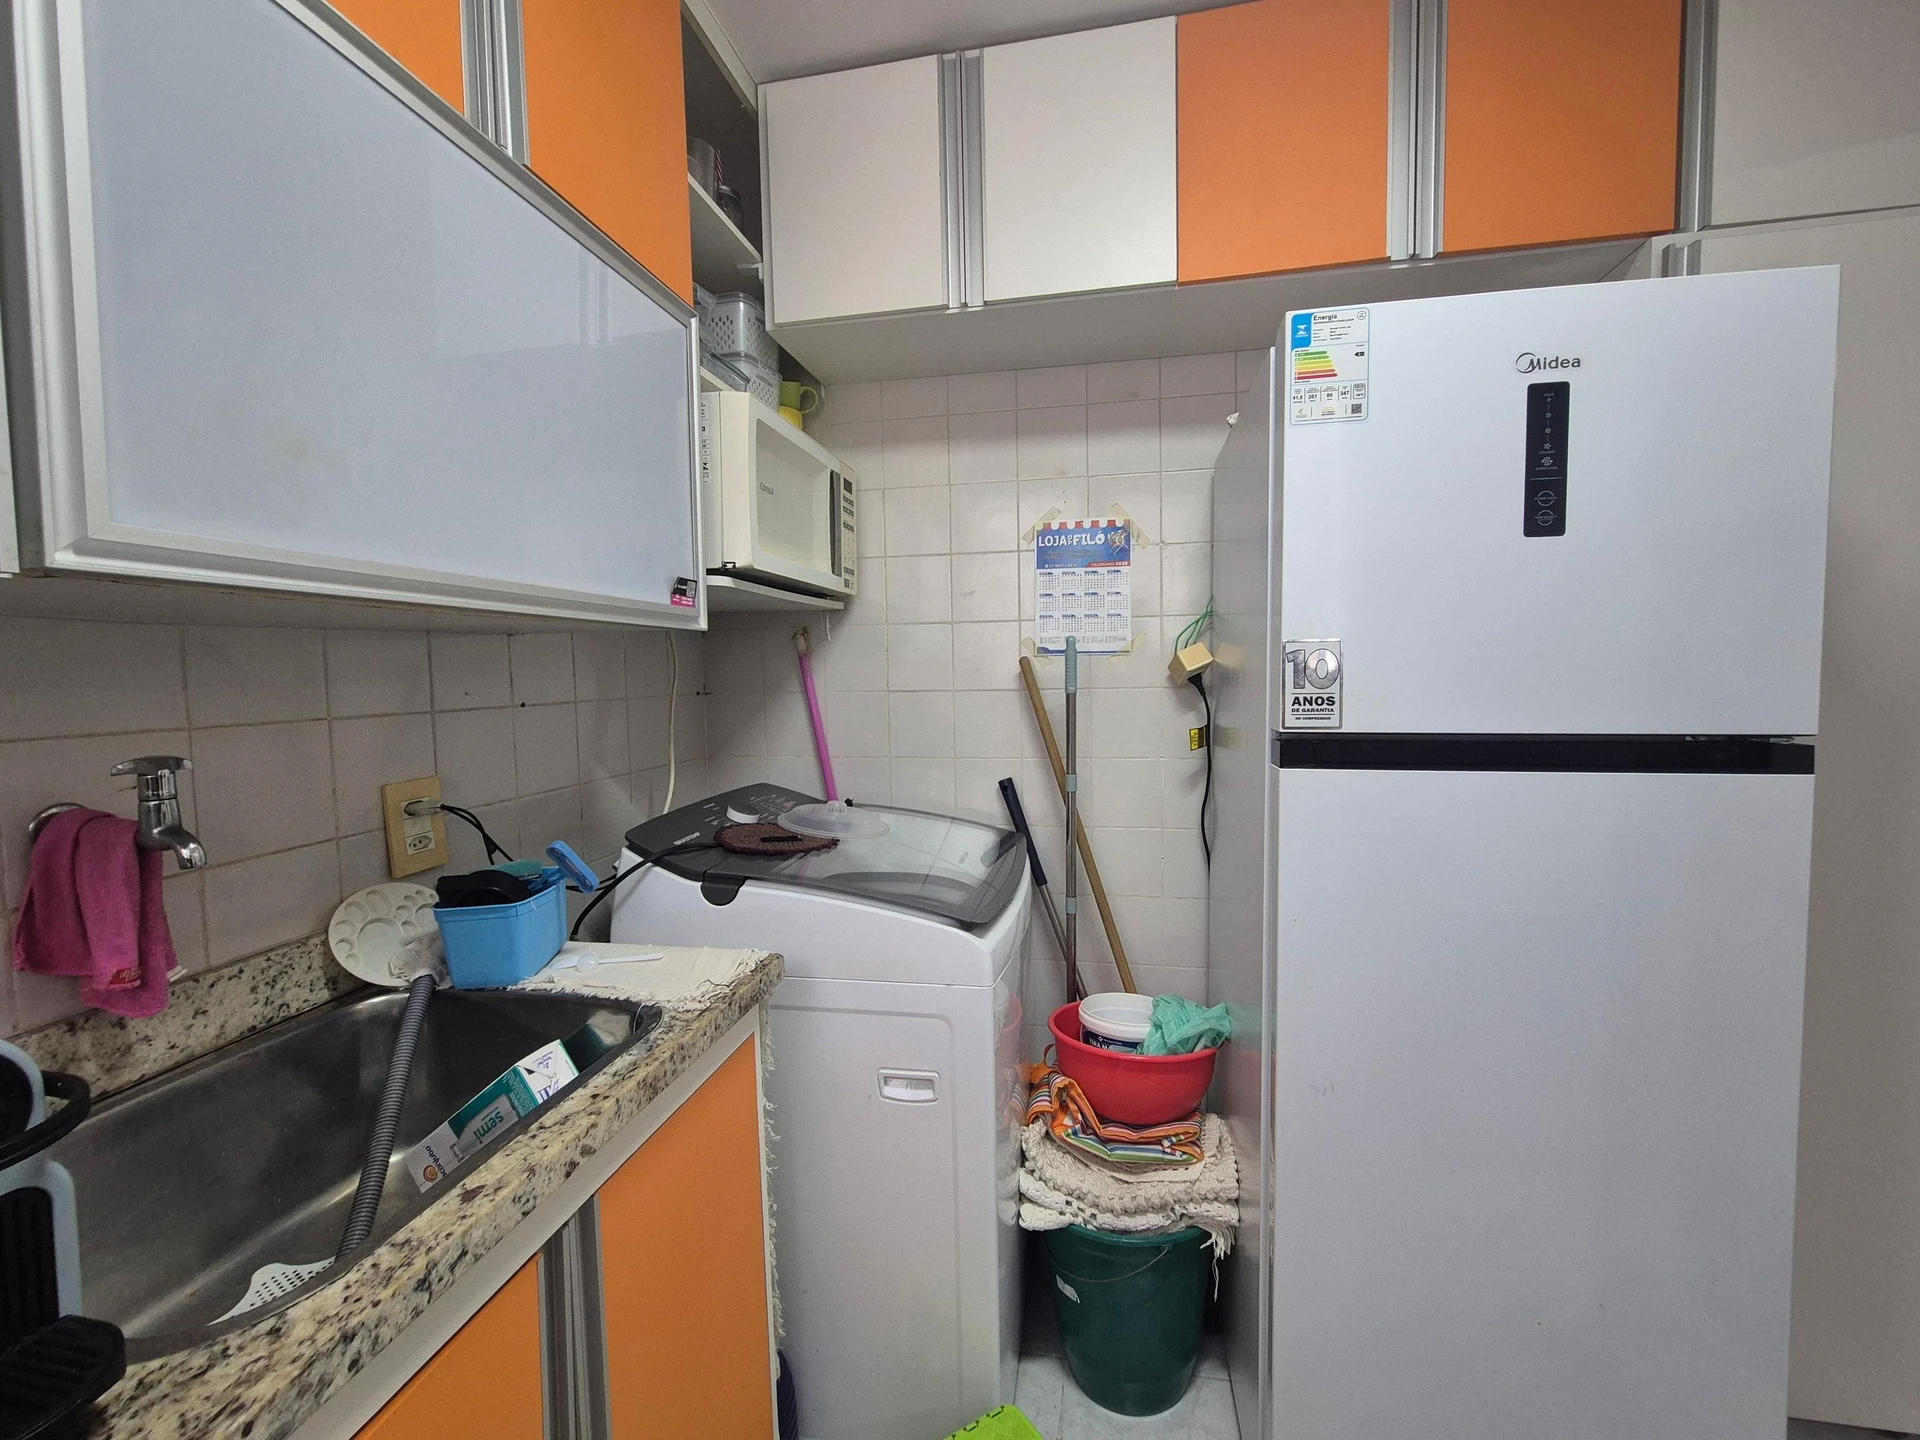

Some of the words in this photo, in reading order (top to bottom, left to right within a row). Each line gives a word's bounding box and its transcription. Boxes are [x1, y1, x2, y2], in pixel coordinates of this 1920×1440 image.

[1516, 352, 1581, 373] Midea
[1038, 535, 1067, 547] LOJA
[1073, 531, 1105, 546] FILÓ
[1286, 648, 1340, 689] 10
[1291, 695, 1336, 707] ANOS
[472, 1110, 505, 1144] semi
